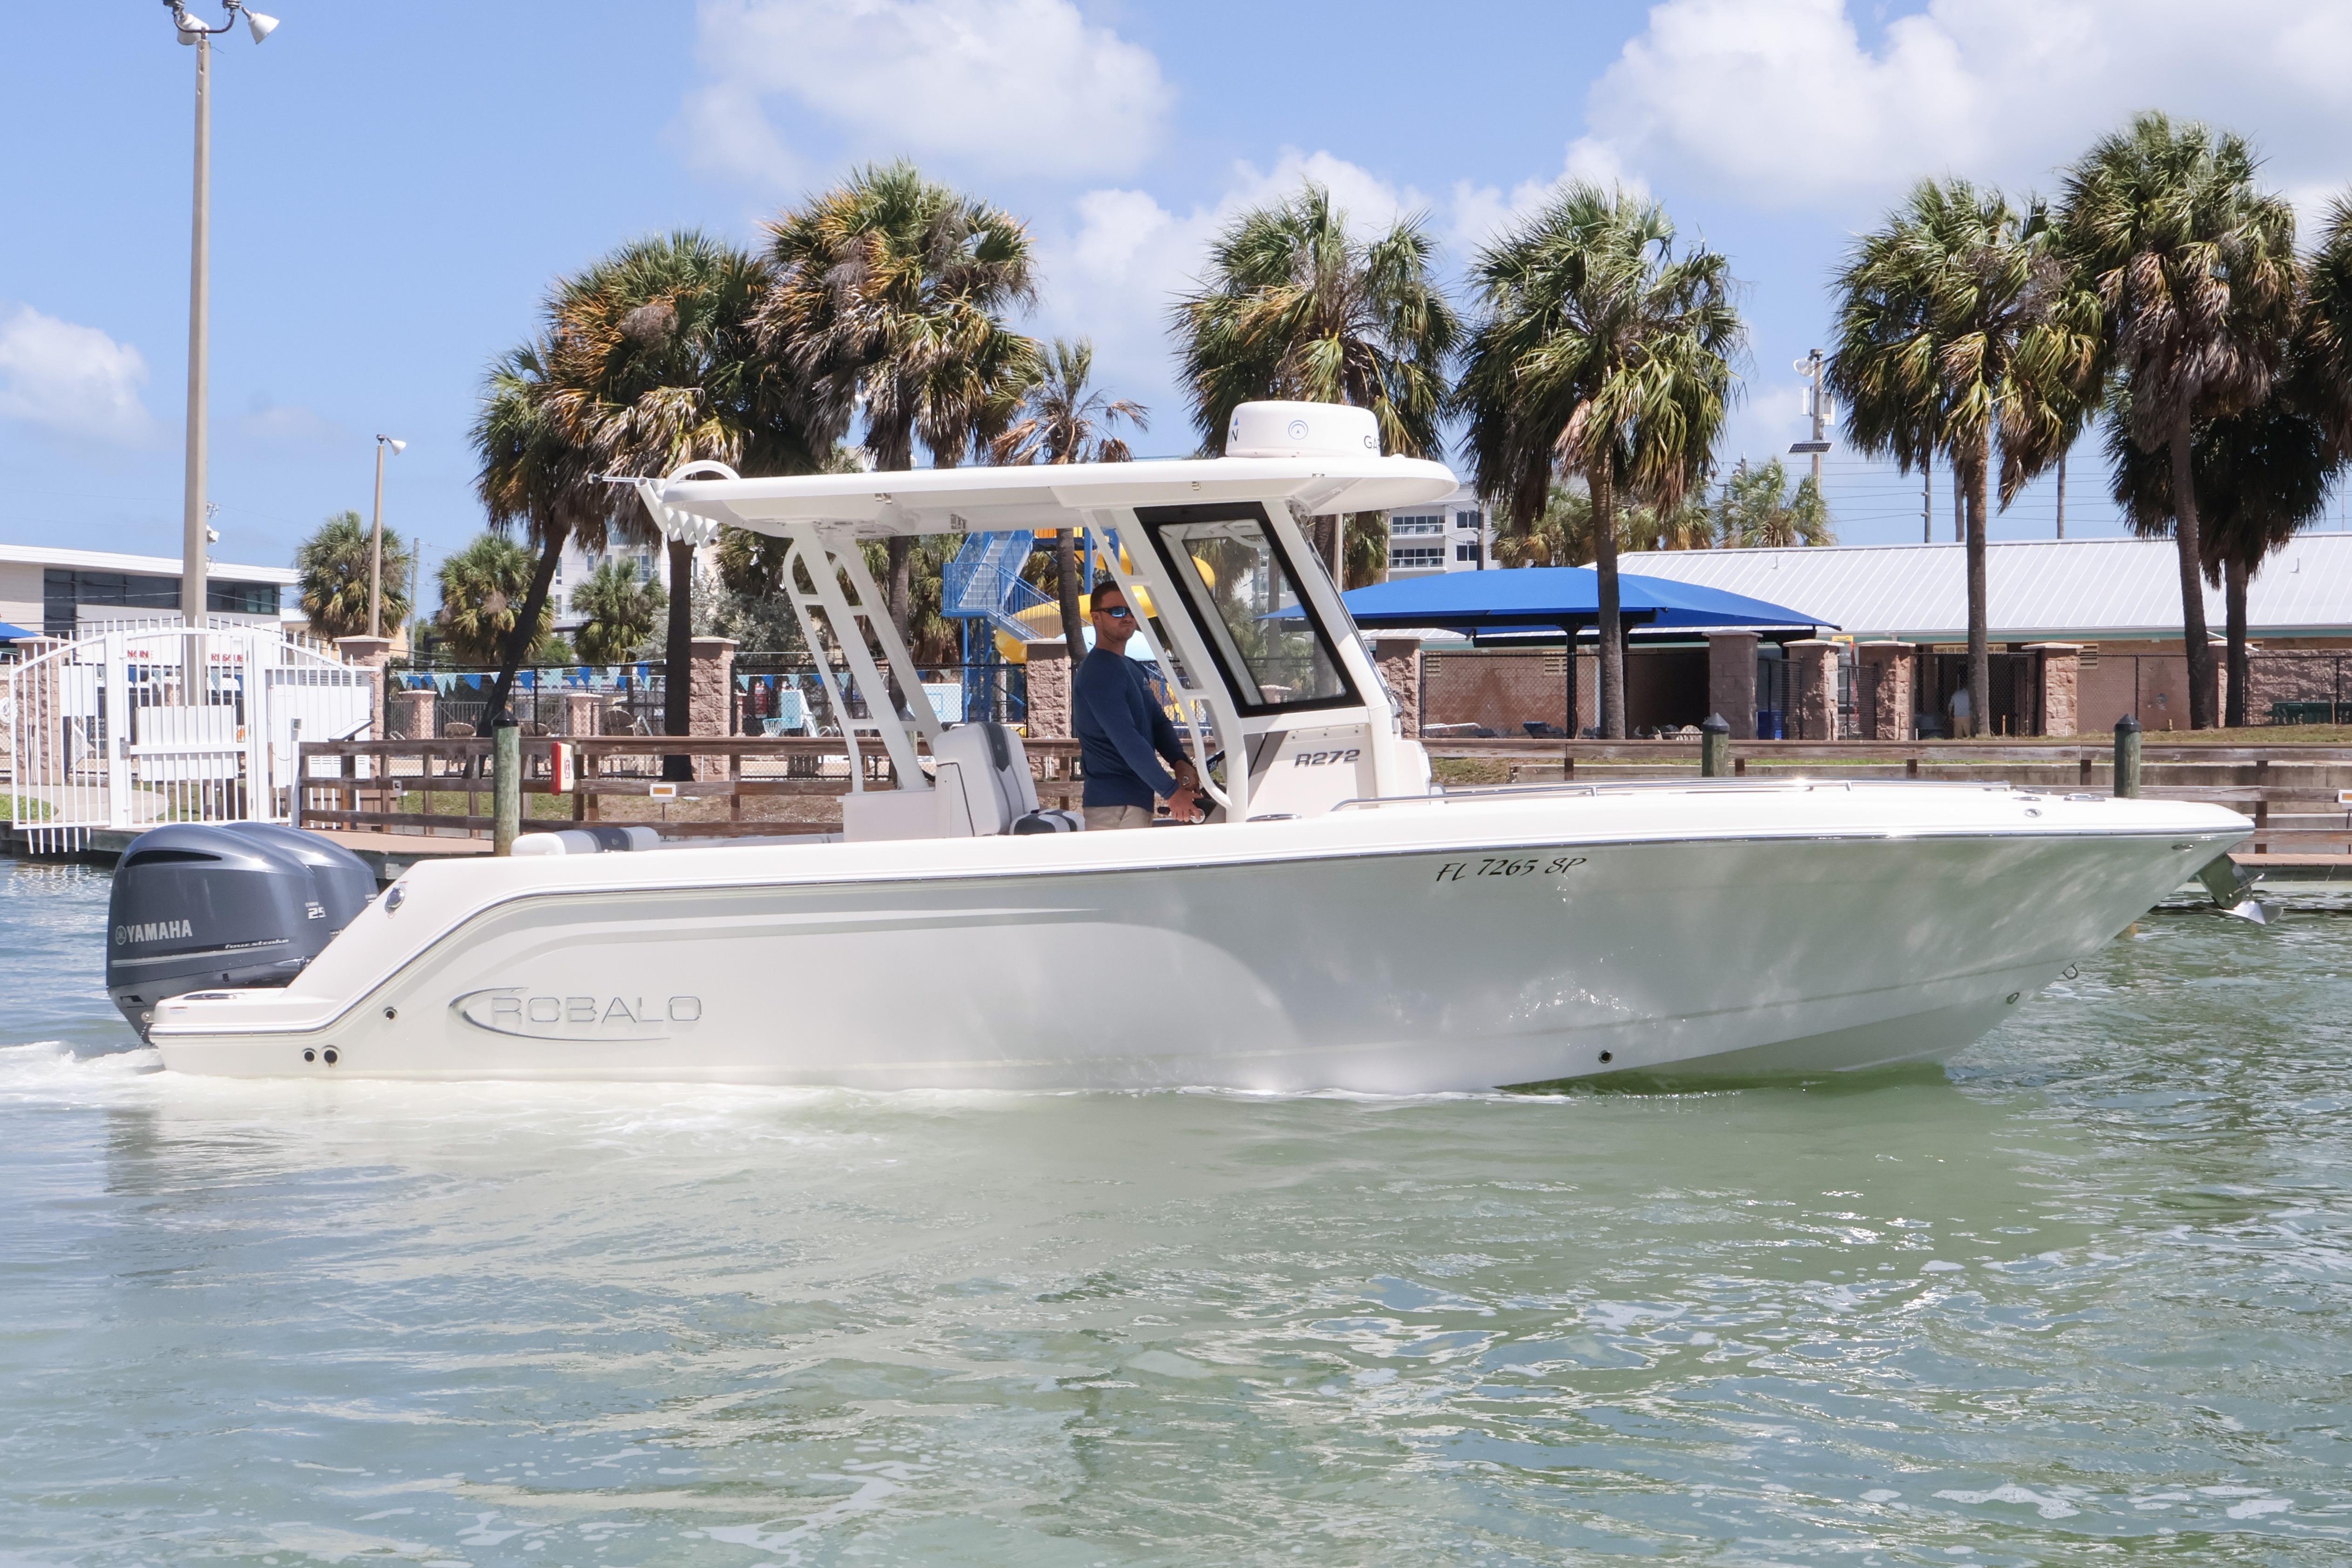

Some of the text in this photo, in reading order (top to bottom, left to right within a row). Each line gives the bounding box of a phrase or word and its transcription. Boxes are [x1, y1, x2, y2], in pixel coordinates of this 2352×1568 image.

[1294, 749, 1360, 768] R272
[1436, 857, 1587, 882] FL 7265 SP
[126, 919, 193, 943] YAMAHA
[492, 996, 702, 1023] ROBALO
